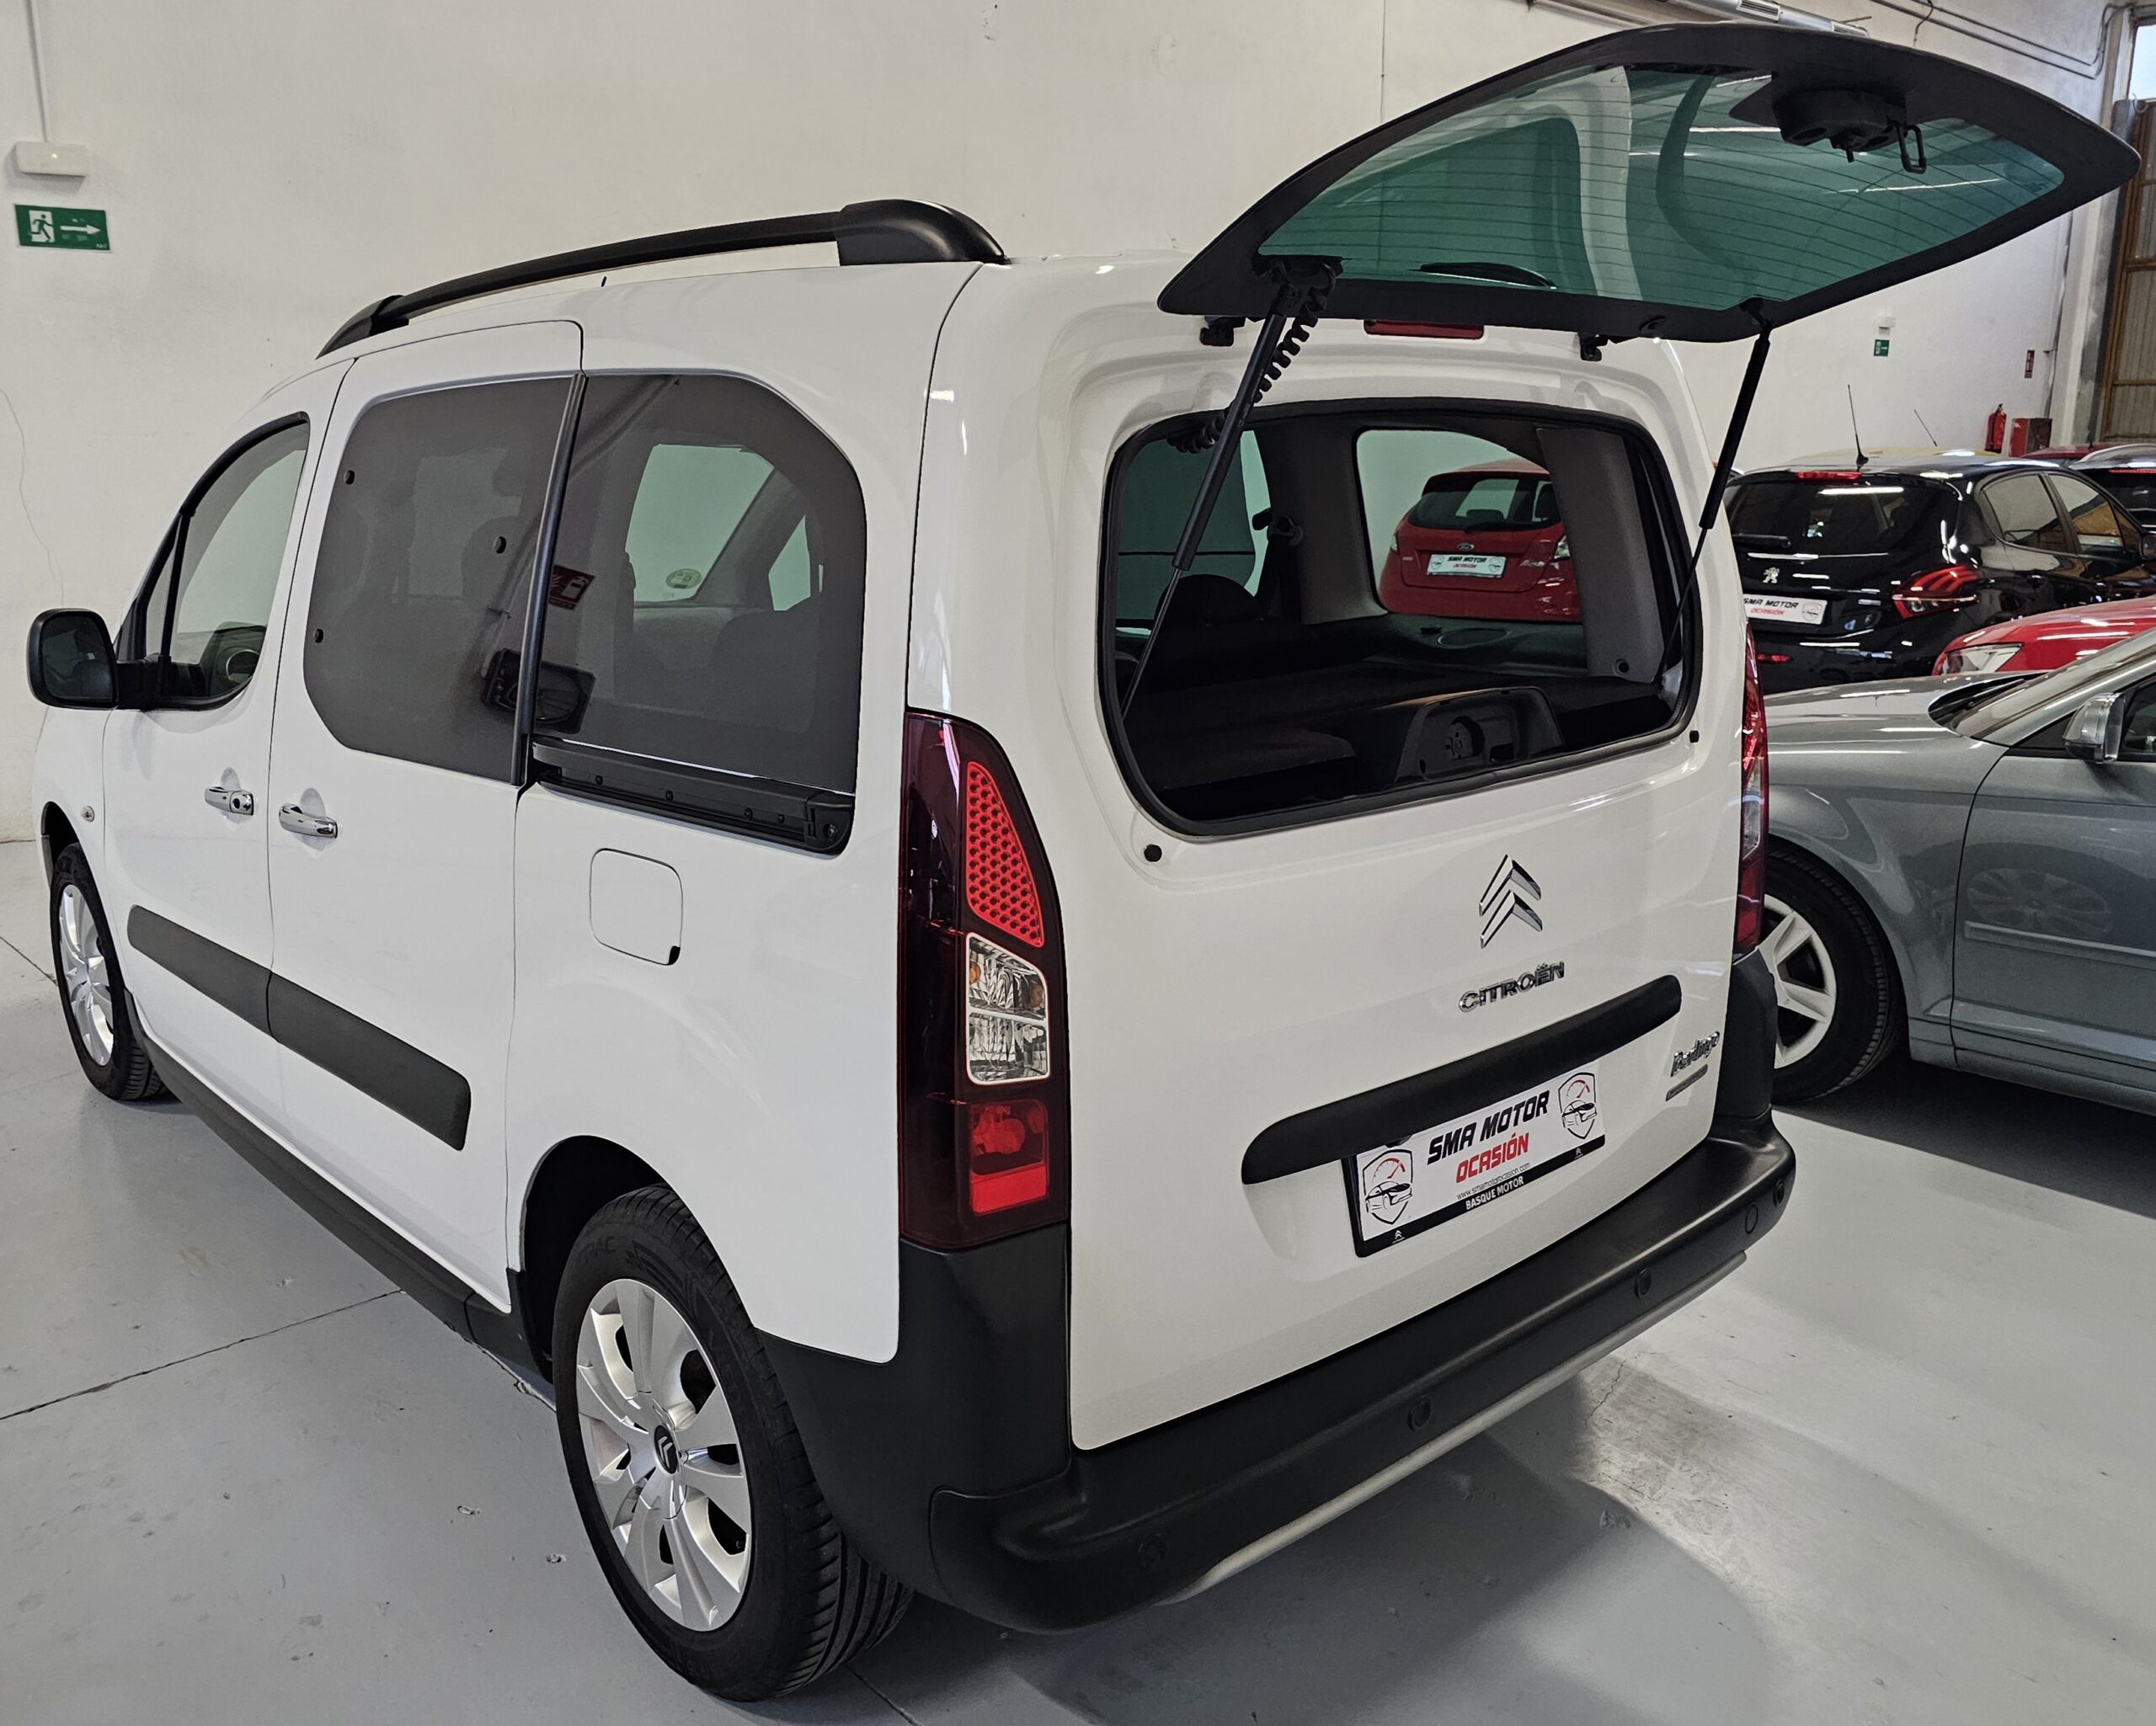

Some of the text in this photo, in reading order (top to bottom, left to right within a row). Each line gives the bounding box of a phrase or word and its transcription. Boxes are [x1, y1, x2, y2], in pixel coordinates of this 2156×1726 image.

[1765, 600, 1799, 609] MOTOR
[1459, 961, 1565, 1013] CITROËN
[1427, 1089, 1550, 1165] SMA MOTOR
[1455, 1132, 1529, 1184] OCASIÓN
[1465, 1175, 1524, 1210] BASQUE MOTOR
